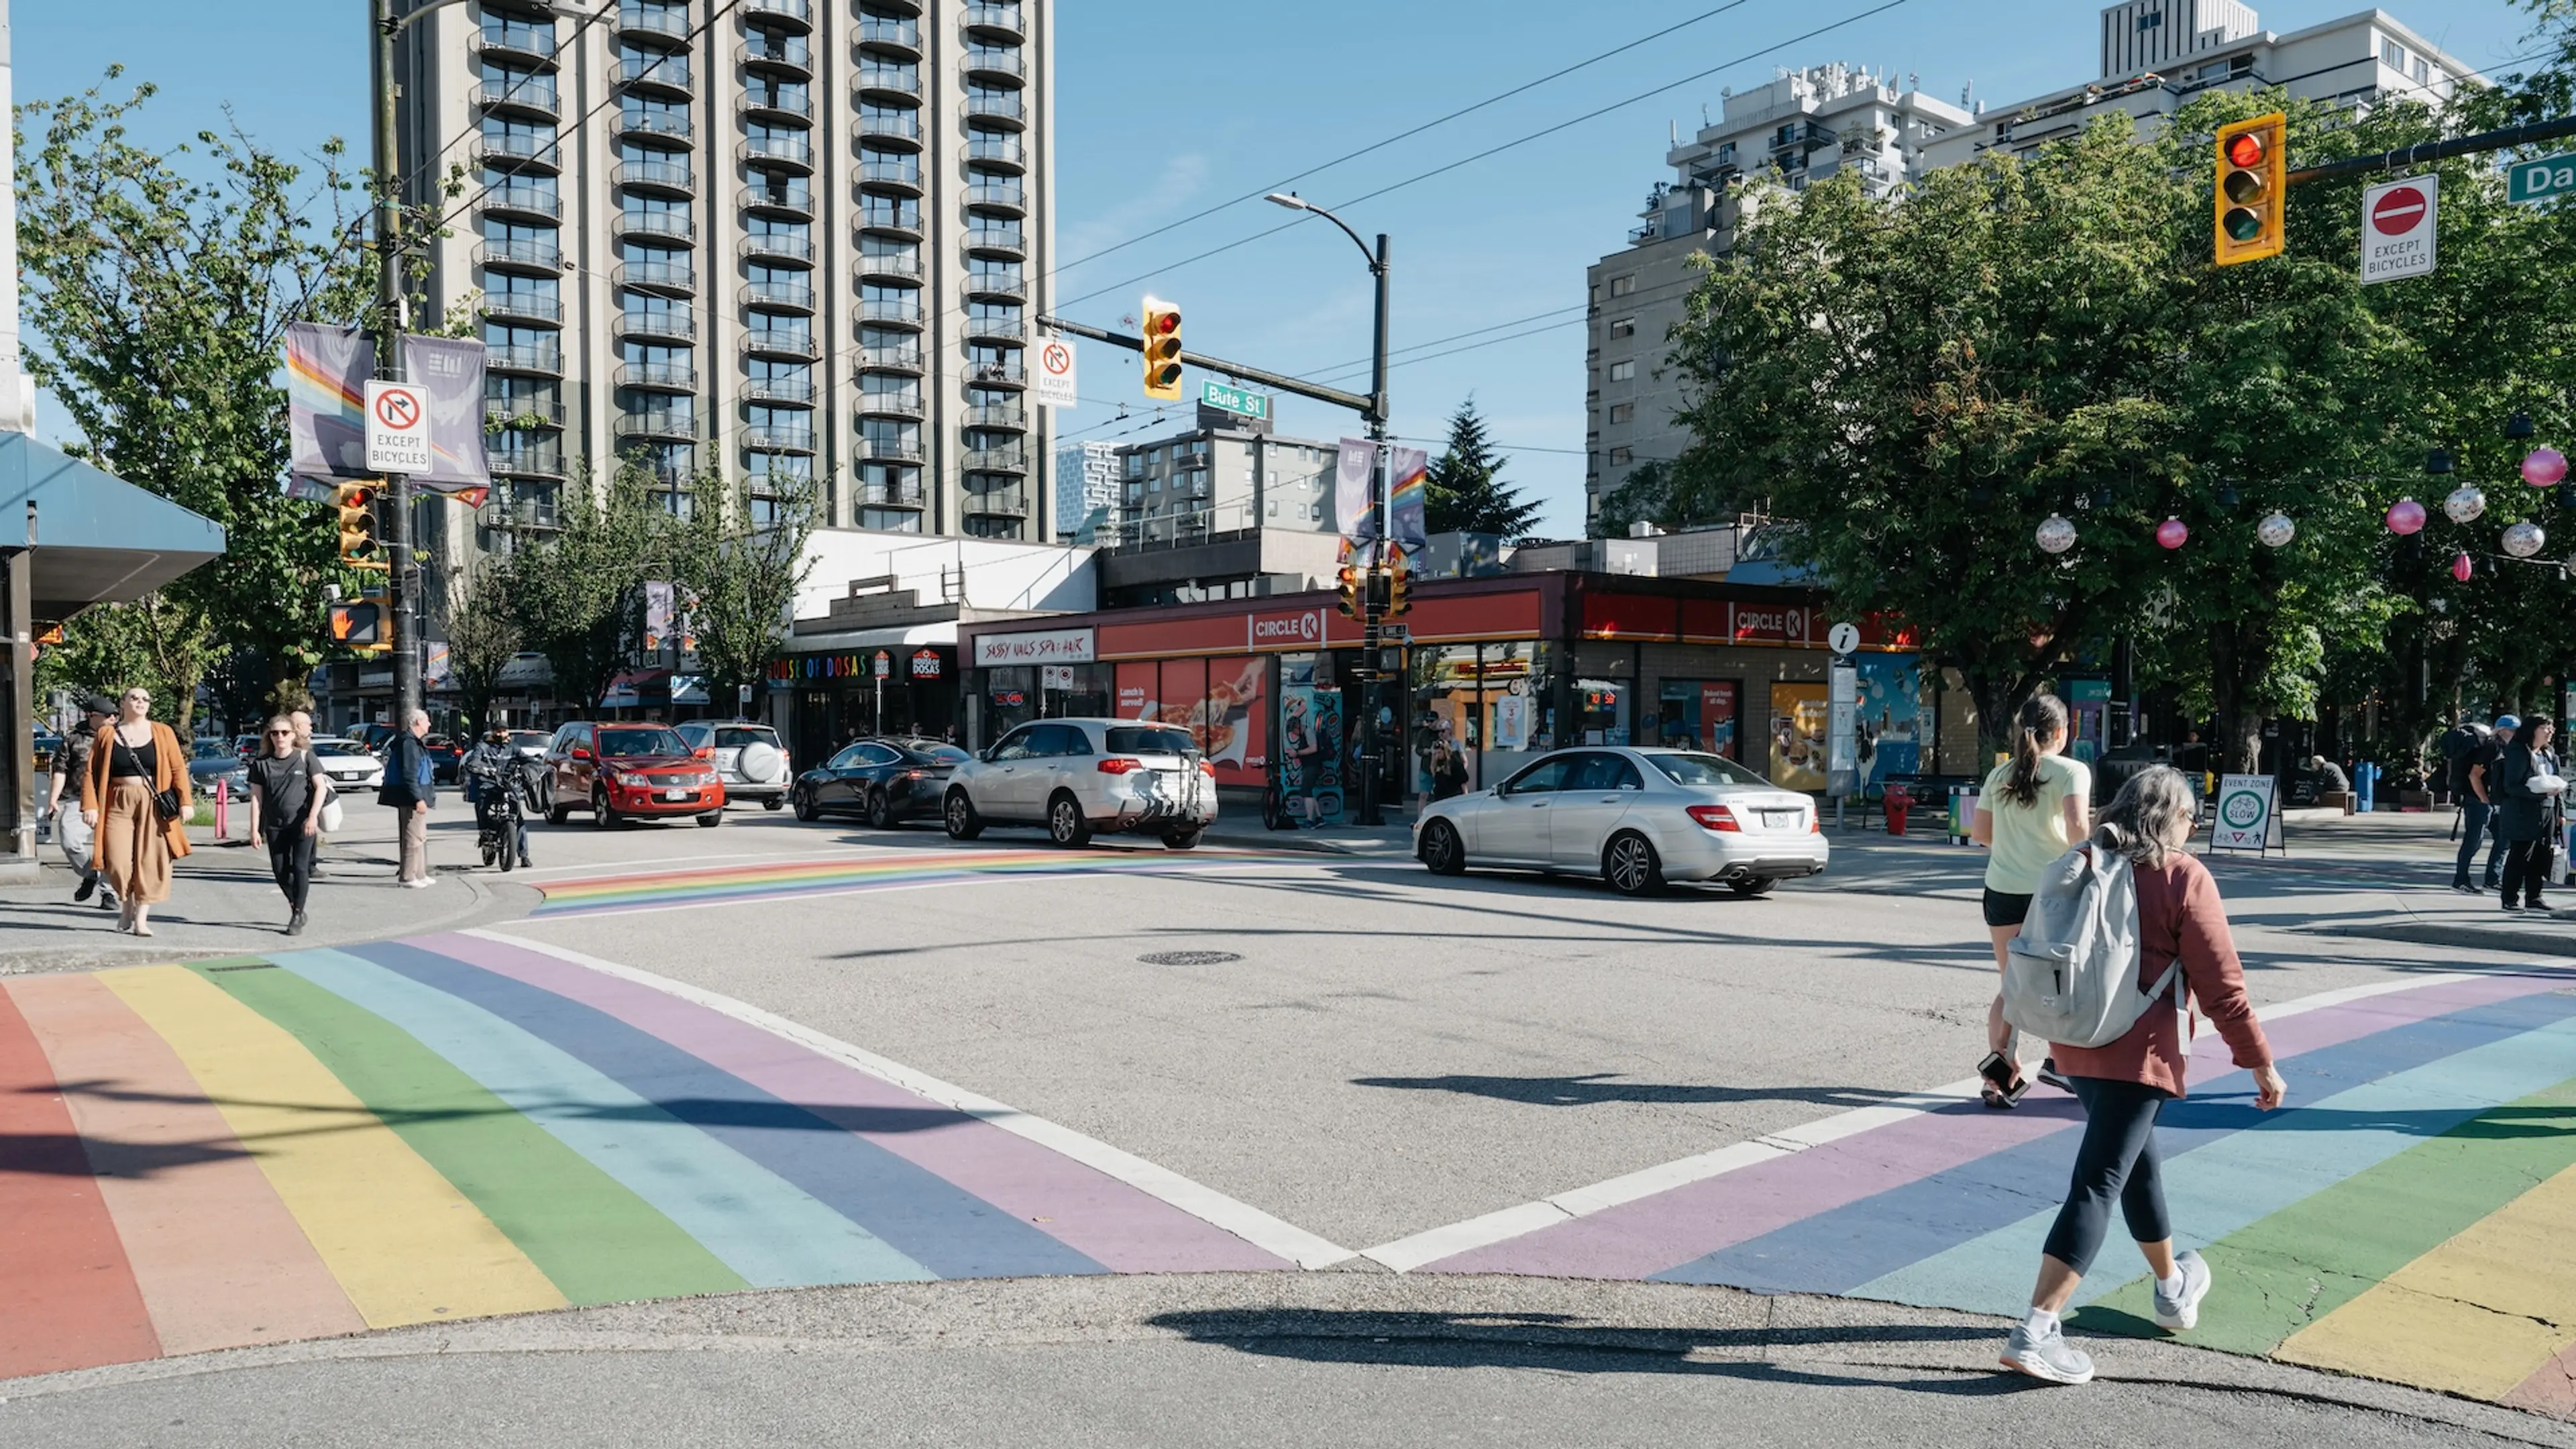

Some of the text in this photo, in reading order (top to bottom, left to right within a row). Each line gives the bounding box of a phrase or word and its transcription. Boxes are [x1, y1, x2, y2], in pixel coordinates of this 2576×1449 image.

[2375, 239, 2421, 258] EXCEPT
[2369, 254, 2426, 273] BICYCLES
[1043, 378, 1070, 388] EXCEPT
[1040, 390, 1073, 402] BICYCLES
[1209, 385, 1260, 414] Bute St
[378, 434, 420, 447] EXCEPT
[372, 450, 427, 464] BICYCLES
[1256, 614, 1317, 637] CIRCLE K
[1737, 611, 1800, 636] CIRCLE K
[985, 642, 1011, 659] SASSY
[1014, 640, 1035, 657] NAILS
[1039, 639, 1055, 656] SPA
[1063, 637, 1084, 655] HAIR
[807, 658, 820, 678] OF
[826, 654, 866, 678] DOSAS
[913, 665, 940, 674] DOSAS
[2224, 778, 2271, 789] EVENT ZONE
[2229, 809, 2256, 819] SLOW
